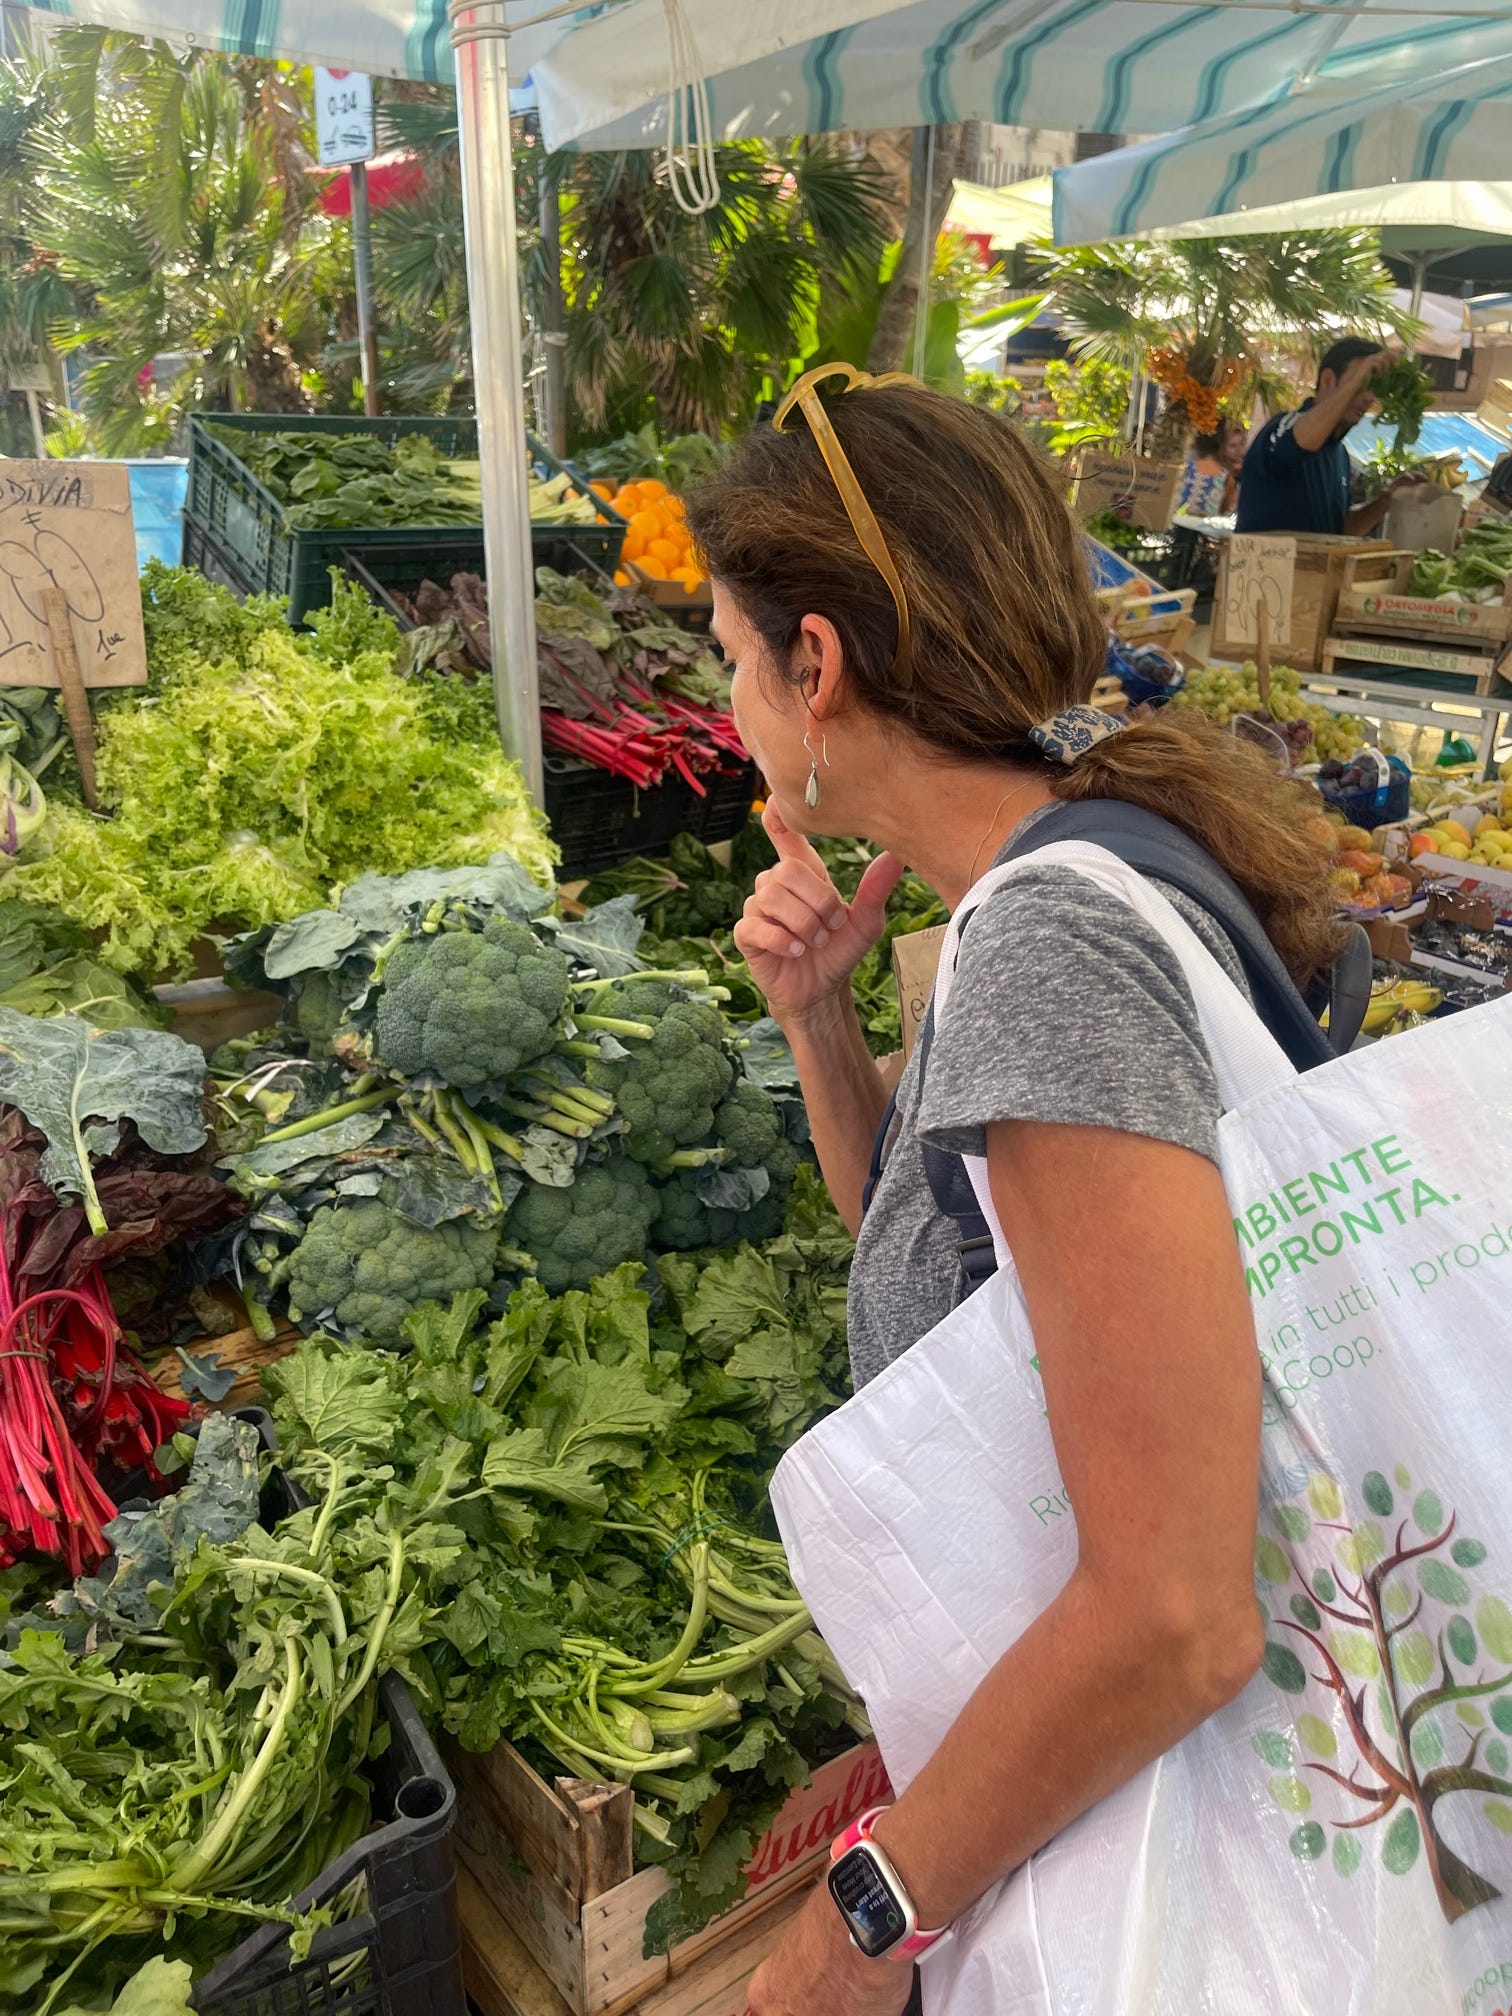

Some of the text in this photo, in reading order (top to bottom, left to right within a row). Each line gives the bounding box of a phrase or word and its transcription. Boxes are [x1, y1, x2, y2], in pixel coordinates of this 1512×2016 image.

[1268, 1221, 1512, 1356] in tutti i prod
